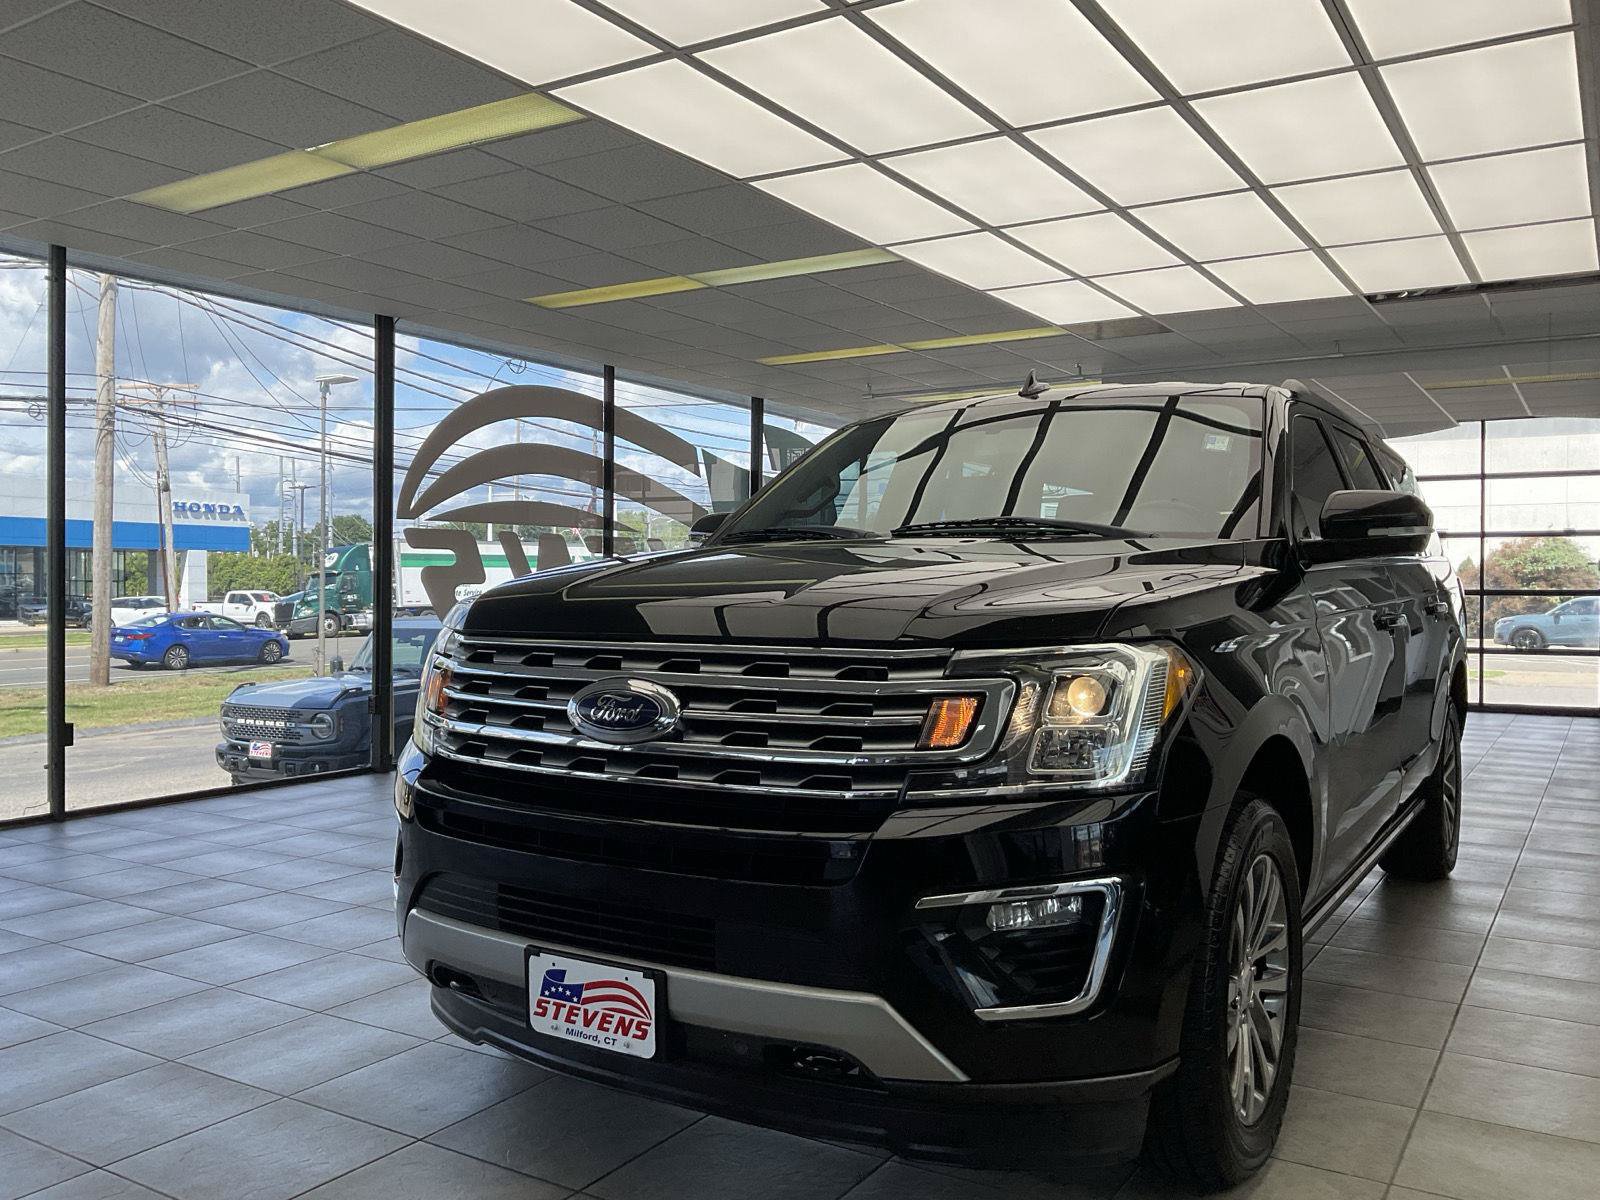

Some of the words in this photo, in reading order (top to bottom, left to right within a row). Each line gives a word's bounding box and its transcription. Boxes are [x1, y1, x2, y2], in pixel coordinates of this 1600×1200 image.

[172, 501, 244, 515] HONDA
[590, 694, 644, 722] Ford
[533, 998, 652, 1041] STEVENS
[565, 1027, 601, 1044] Milford,
[603, 1036, 618, 1047] CT
